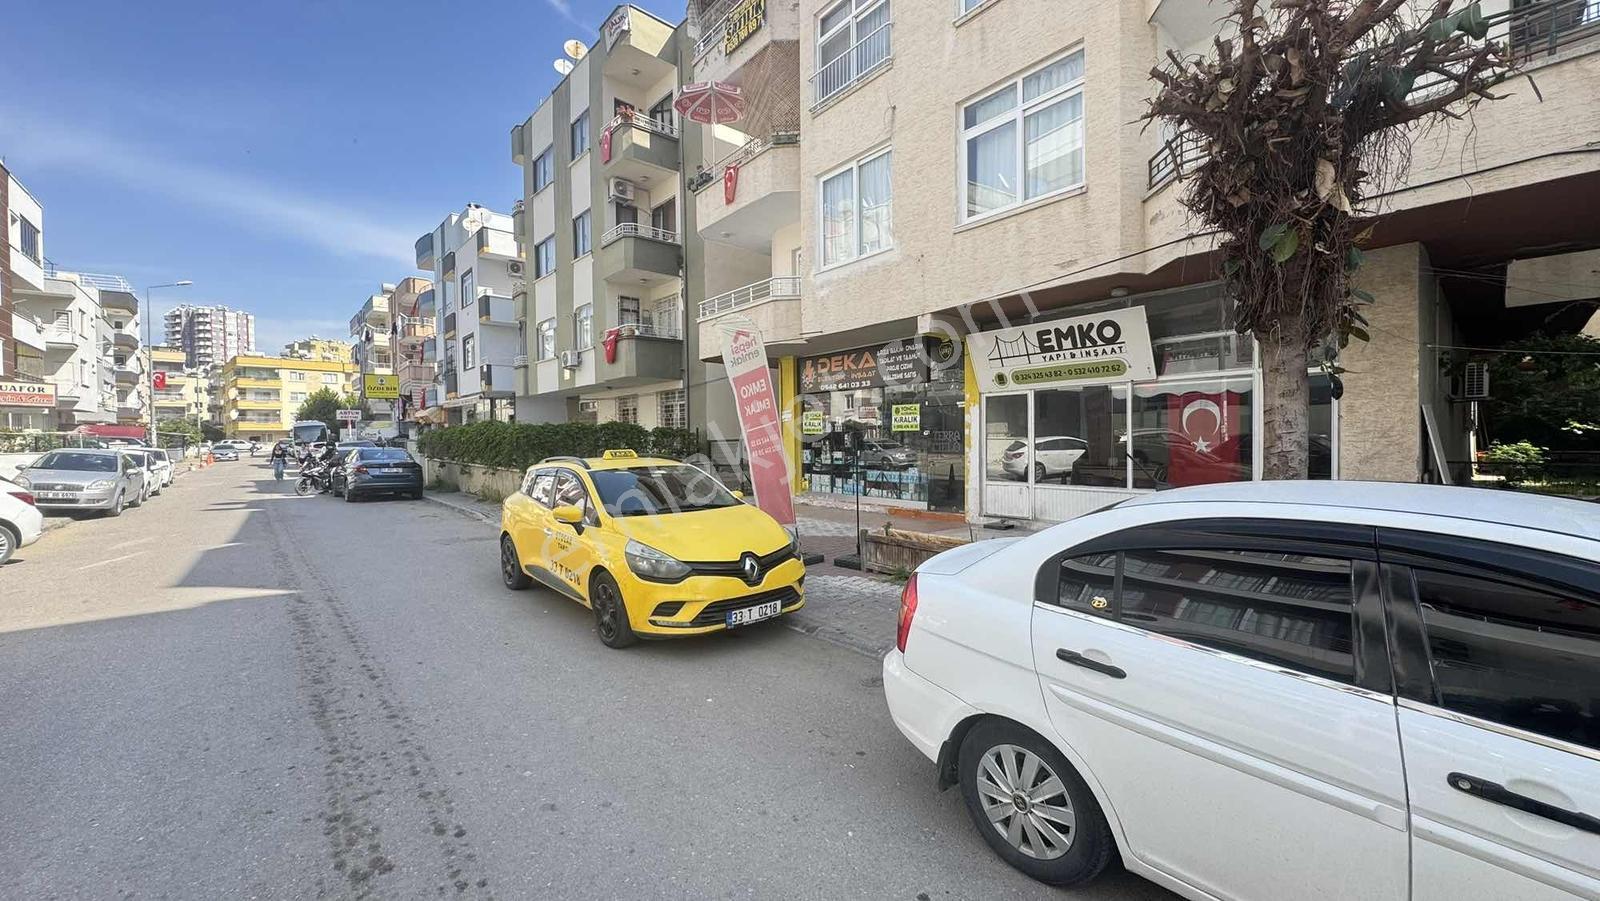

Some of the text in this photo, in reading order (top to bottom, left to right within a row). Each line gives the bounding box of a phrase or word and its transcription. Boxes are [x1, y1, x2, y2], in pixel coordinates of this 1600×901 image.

[1036, 319, 1122, 352] EMKO
[818, 351, 877, 374] DEKA
[1042, 351, 1069, 361] YAPI
[1070, 351, 1076, 359] &
[1074, 367, 1086, 375] 532
[1087, 366, 1100, 374] 410
[1101, 365, 1110, 373] 72
[1111, 364, 1121, 372] 62
[732, 602, 778, 623] 33 T 0218
